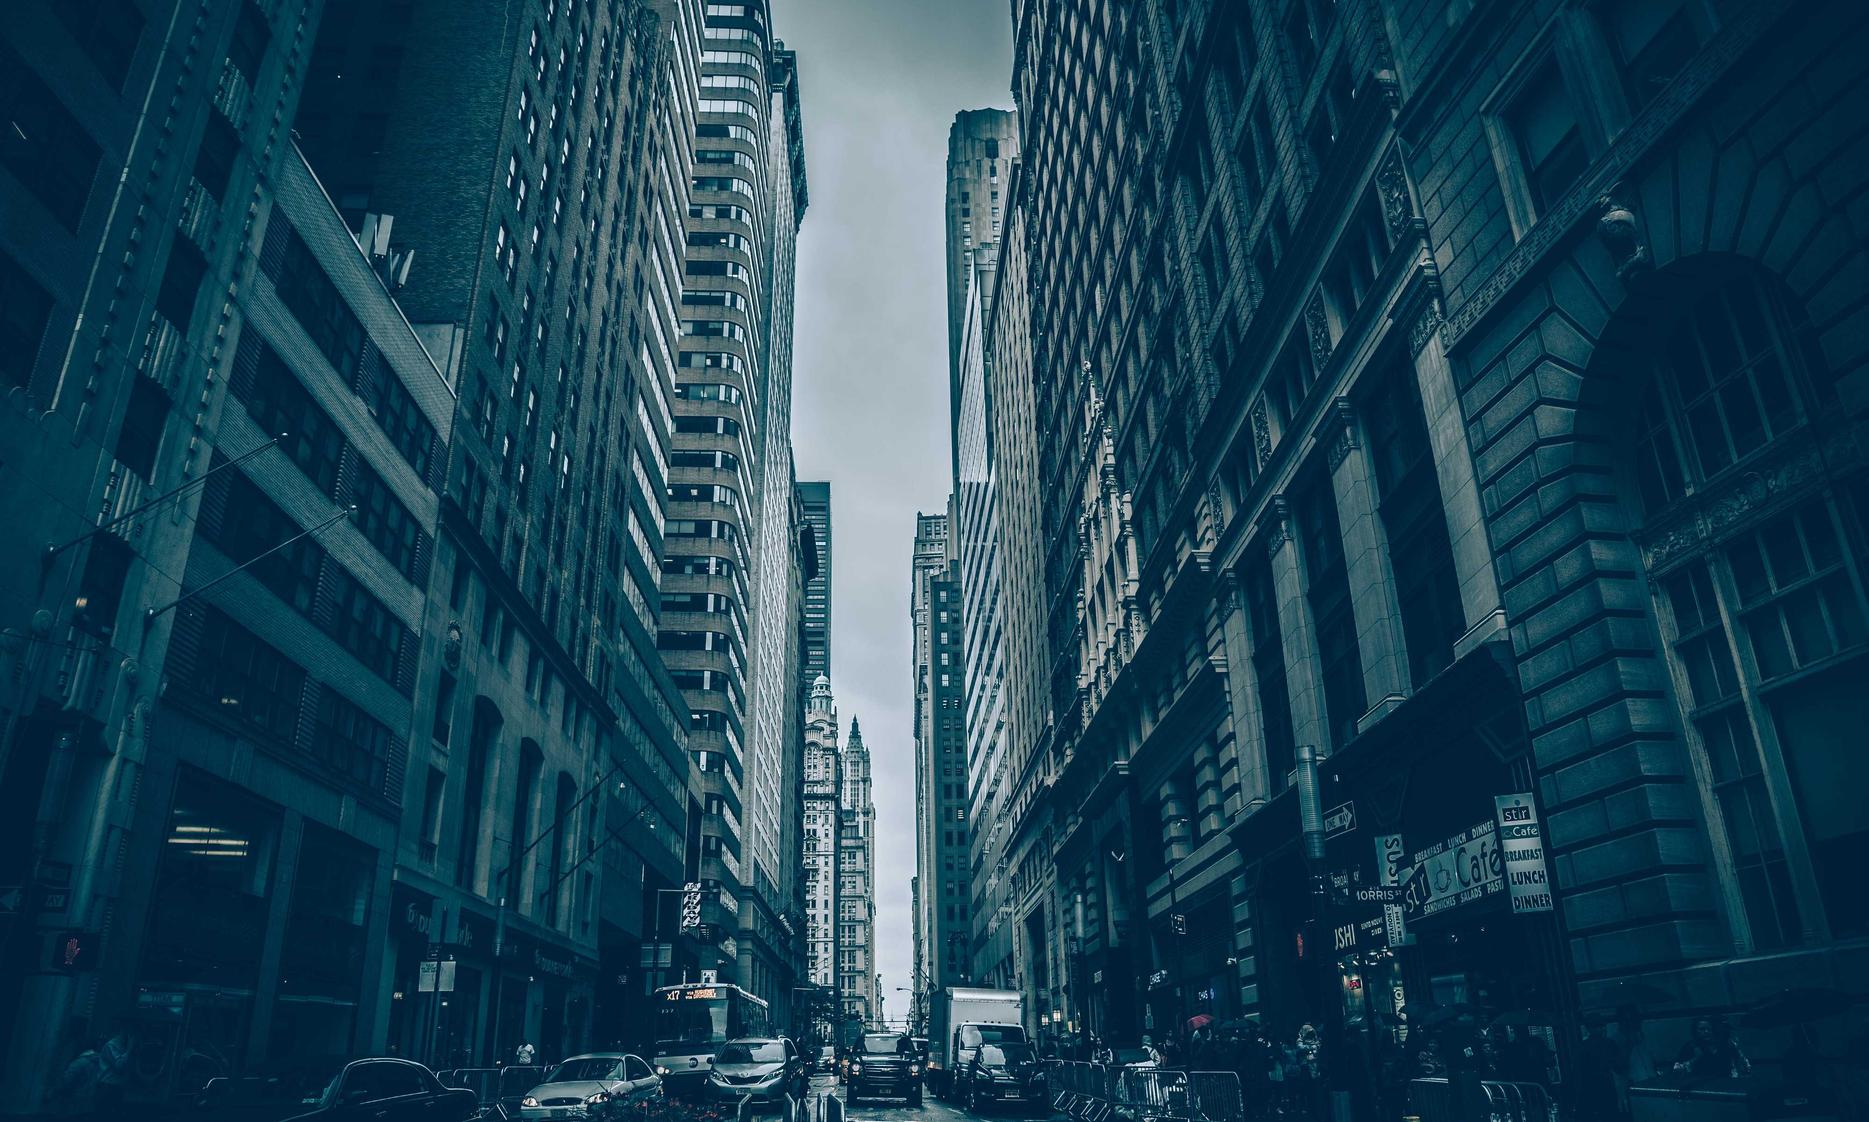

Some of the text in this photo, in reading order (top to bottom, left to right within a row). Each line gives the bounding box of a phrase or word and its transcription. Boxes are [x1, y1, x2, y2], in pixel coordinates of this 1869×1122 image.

[1505, 808, 1527, 821] stir
[1415, 820, 1495, 863] BREAKFAST LUNCH DINNER
[1504, 848, 1542, 862] BREAKFAST
[1456, 840, 1502, 888] Café
[1510, 870, 1546, 886] LUNCH
[1423, 896, 1457, 915] SANDWICHES
[1460, 887, 1482, 903] SALADS
[1513, 894, 1552, 910] DINNER
